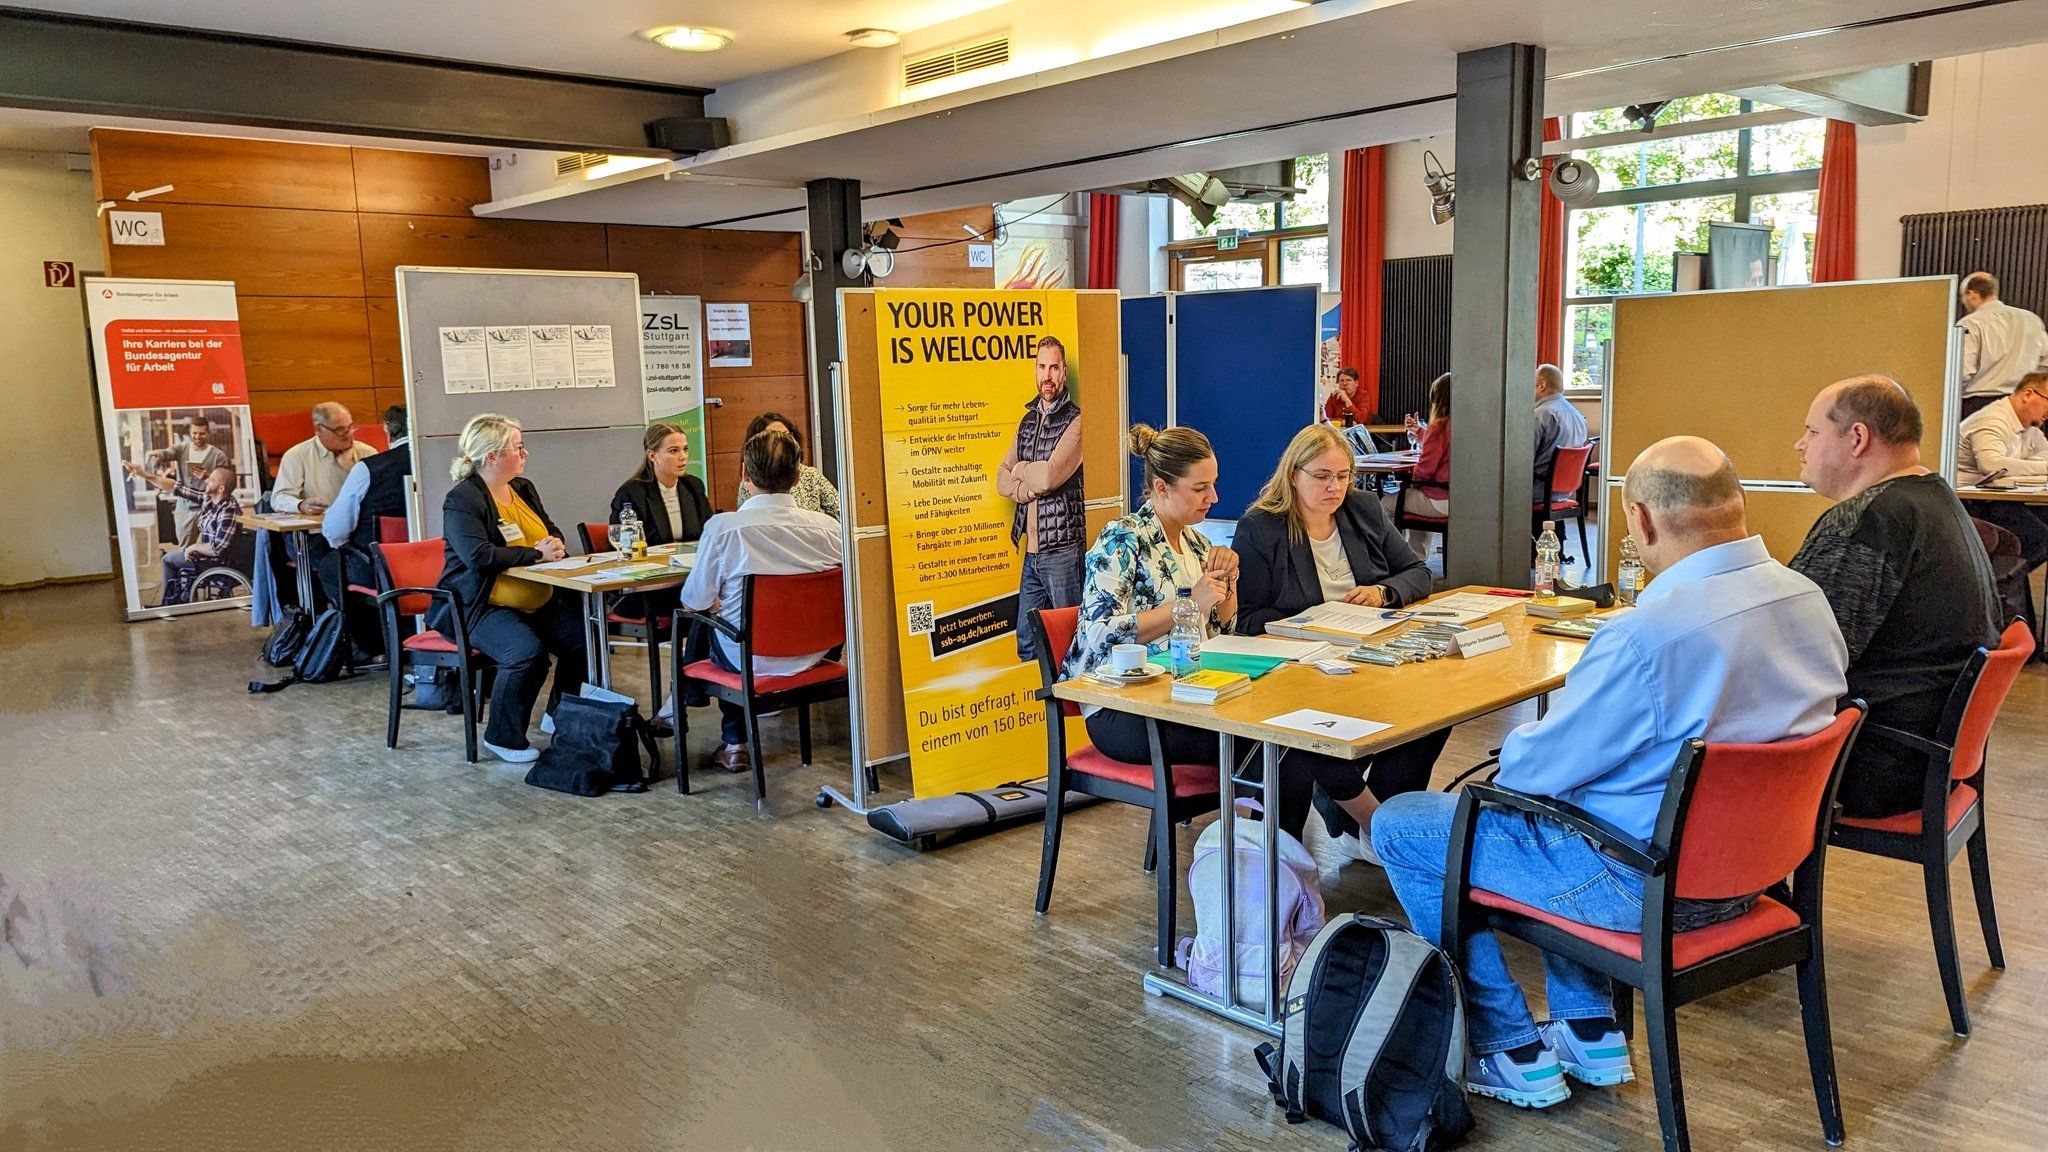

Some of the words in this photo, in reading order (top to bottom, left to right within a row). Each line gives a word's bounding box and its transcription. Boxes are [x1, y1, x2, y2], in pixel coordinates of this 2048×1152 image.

[115, 220, 148, 237] WC
[971, 250, 986, 262] WC
[643, 313, 689, 330] ZsL
[887, 302, 955, 328] YOUR
[963, 302, 1043, 327] POWER
[122, 340, 143, 349] Ihre
[146, 340, 186, 349] Karriere
[188, 340, 204, 349] bei
[206, 340, 223, 349] der
[643, 332, 689, 342] Stuttgart
[124, 351, 202, 361] Bundesagentur
[891, 337, 914, 364] IS
[921, 335, 1037, 362] WELCOME
[125, 362, 141, 372] für
[143, 362, 175, 372] Arbeit
[907, 403, 928, 413] Sorge
[930, 402, 941, 411] für
[942, 401, 960, 410] mehr
[962, 400, 989, 409] Lebens-
[908, 415, 937, 426] qualität
[938, 414, 945, 422] in
[947, 413, 979, 423] Stuttgart
[909, 434, 944, 444] Entwickle
[946, 433, 956, 441] die
[958, 430, 1001, 440] Infrastruktur
[910, 449, 920, 457] im
[921, 445, 942, 456] ÖPNV
[944, 446, 965, 454] weiter
[911, 466, 941, 476] Gestalte
[943, 463, 982, 473] nachhaltige
[912, 478, 946, 488] Mobilität
[947, 476, 959, 485] mit
[961, 473, 988, 484] Zukunft
[913, 499, 931, 508] Lebe
[932, 496, 952, 506] Deine
[953, 493, 982, 502] Visionen
[914, 511, 931, 520] und
[931, 507, 971, 518] Fähigkeiten
[916, 530, 939, 539] Bringe
[941, 527, 957, 535] über
[959, 525, 972, 533] 230
[973, 521, 1005, 531] Millionen
[917, 541, 951, 551] Fahrgäste
[953, 538, 961, 546] im
[963, 536, 977, 545] Jahr
[978, 534, 998, 542] voran
[918, 560, 947, 570] Gestalte
[949, 557, 955, 565] in
[957, 555, 977, 563] einem
[978, 552, 996, 561] Team
[997, 550, 1009, 558] mit
[919, 574, 936, 582] über
[937, 570, 957, 580] 3.300
[959, 562, 1010, 576] Mitarbeitenden
[939, 622, 957, 634] Jetzt
[958, 611, 995, 627] bewerben:
[941, 619, 1008, 647] ssb-ag.de/karriere
[919, 711, 937, 727] Du
[942, 704, 966, 721] bist
[970, 691, 1019, 719] gefragt,
[1312, 721, 1338, 729] A
[921, 732, 961, 752] einem
[965, 725, 989, 741] von
[993, 715, 1015, 734] 150
